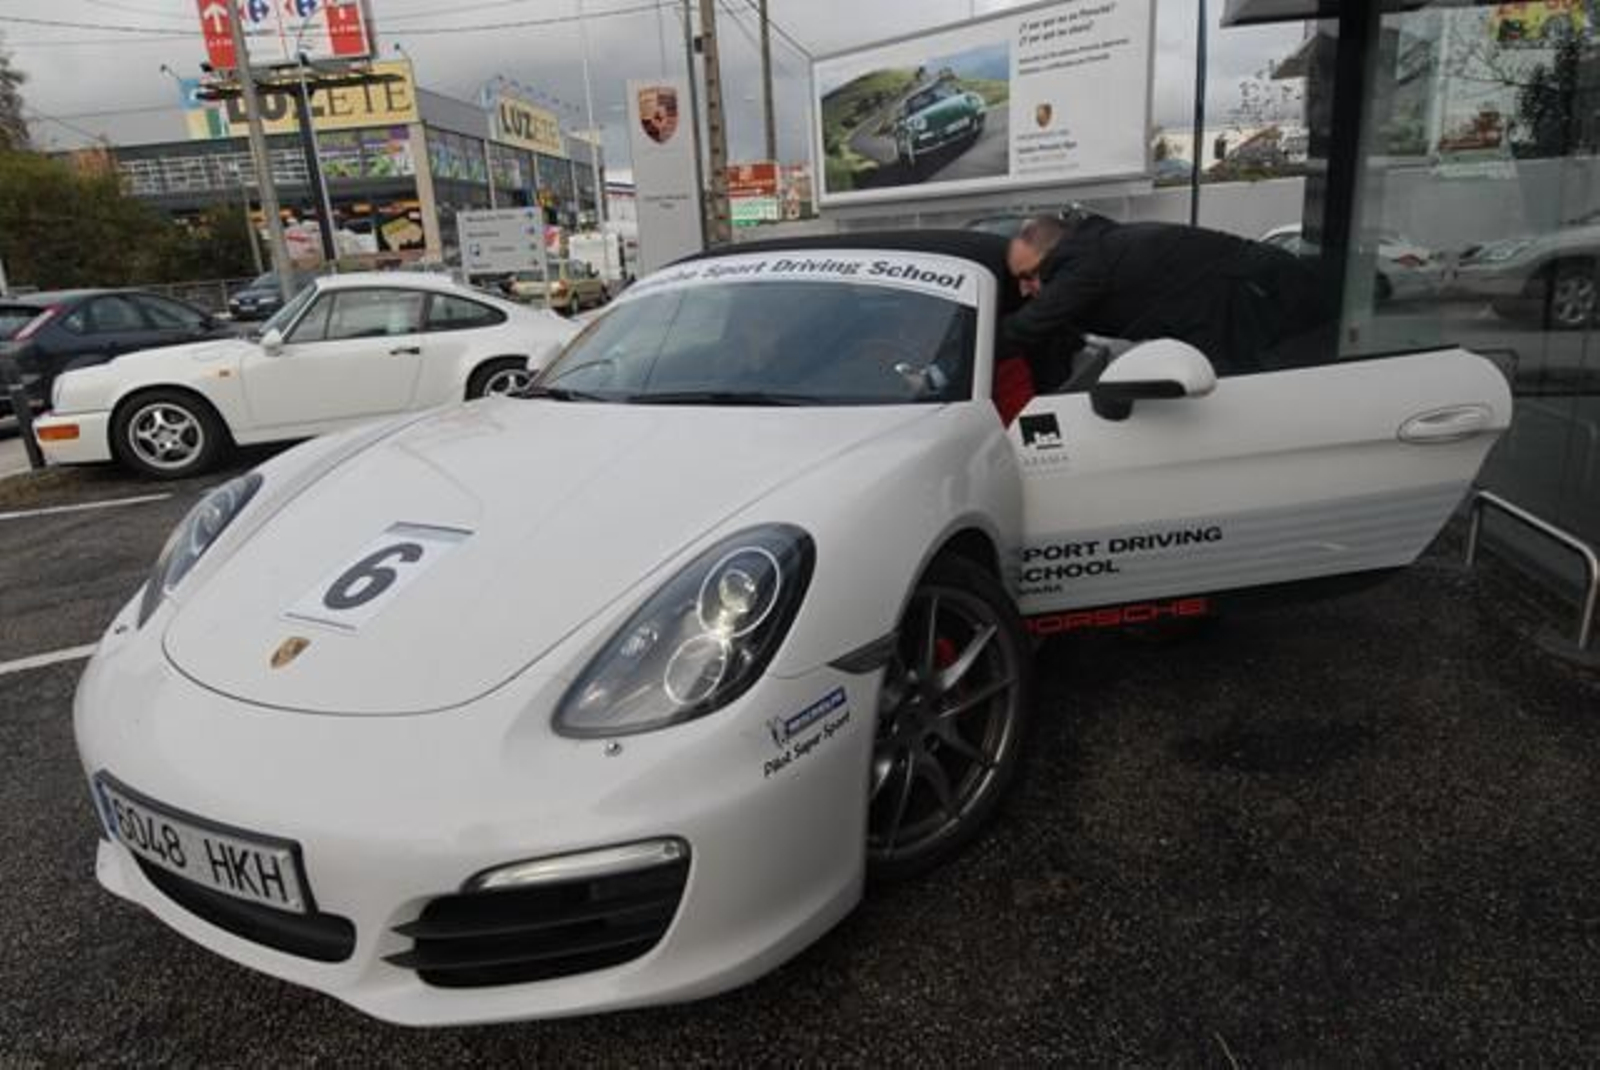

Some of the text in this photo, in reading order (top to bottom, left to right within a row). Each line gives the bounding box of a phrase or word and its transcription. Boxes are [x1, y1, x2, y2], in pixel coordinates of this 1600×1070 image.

[226, 78, 412, 123] LUETE
[702, 259, 768, 279] Sport
[770, 257, 862, 276] Driving
[868, 260, 966, 291] School
[1020, 526, 1222, 563] PORT DRIVING
[322, 542, 424, 610] 6
[1019, 559, 1120, 583] CHOOL
[794, 733, 822, 759] Super
[824, 710, 850, 739] Sport
[206, 839, 288, 904] HKH
